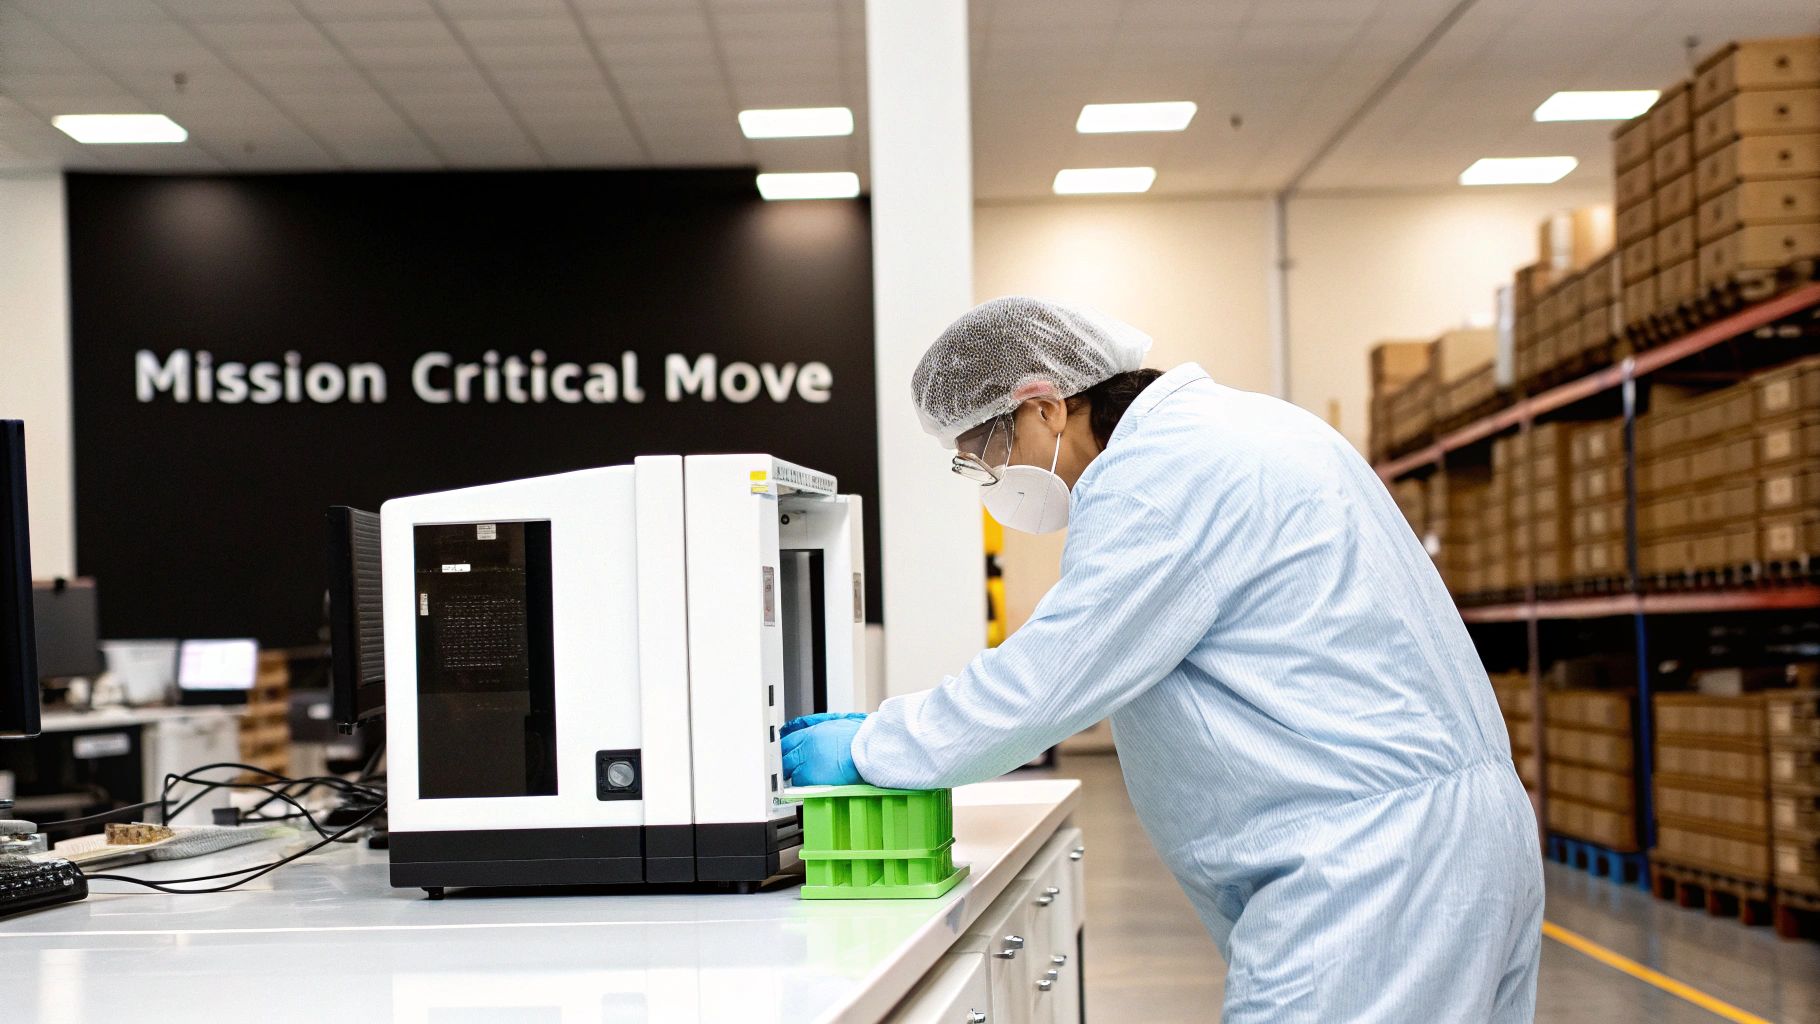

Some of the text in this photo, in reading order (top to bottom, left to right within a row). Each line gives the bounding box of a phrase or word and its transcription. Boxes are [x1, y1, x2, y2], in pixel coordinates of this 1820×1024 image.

[136, 350, 833, 403] Mission Critical Move
